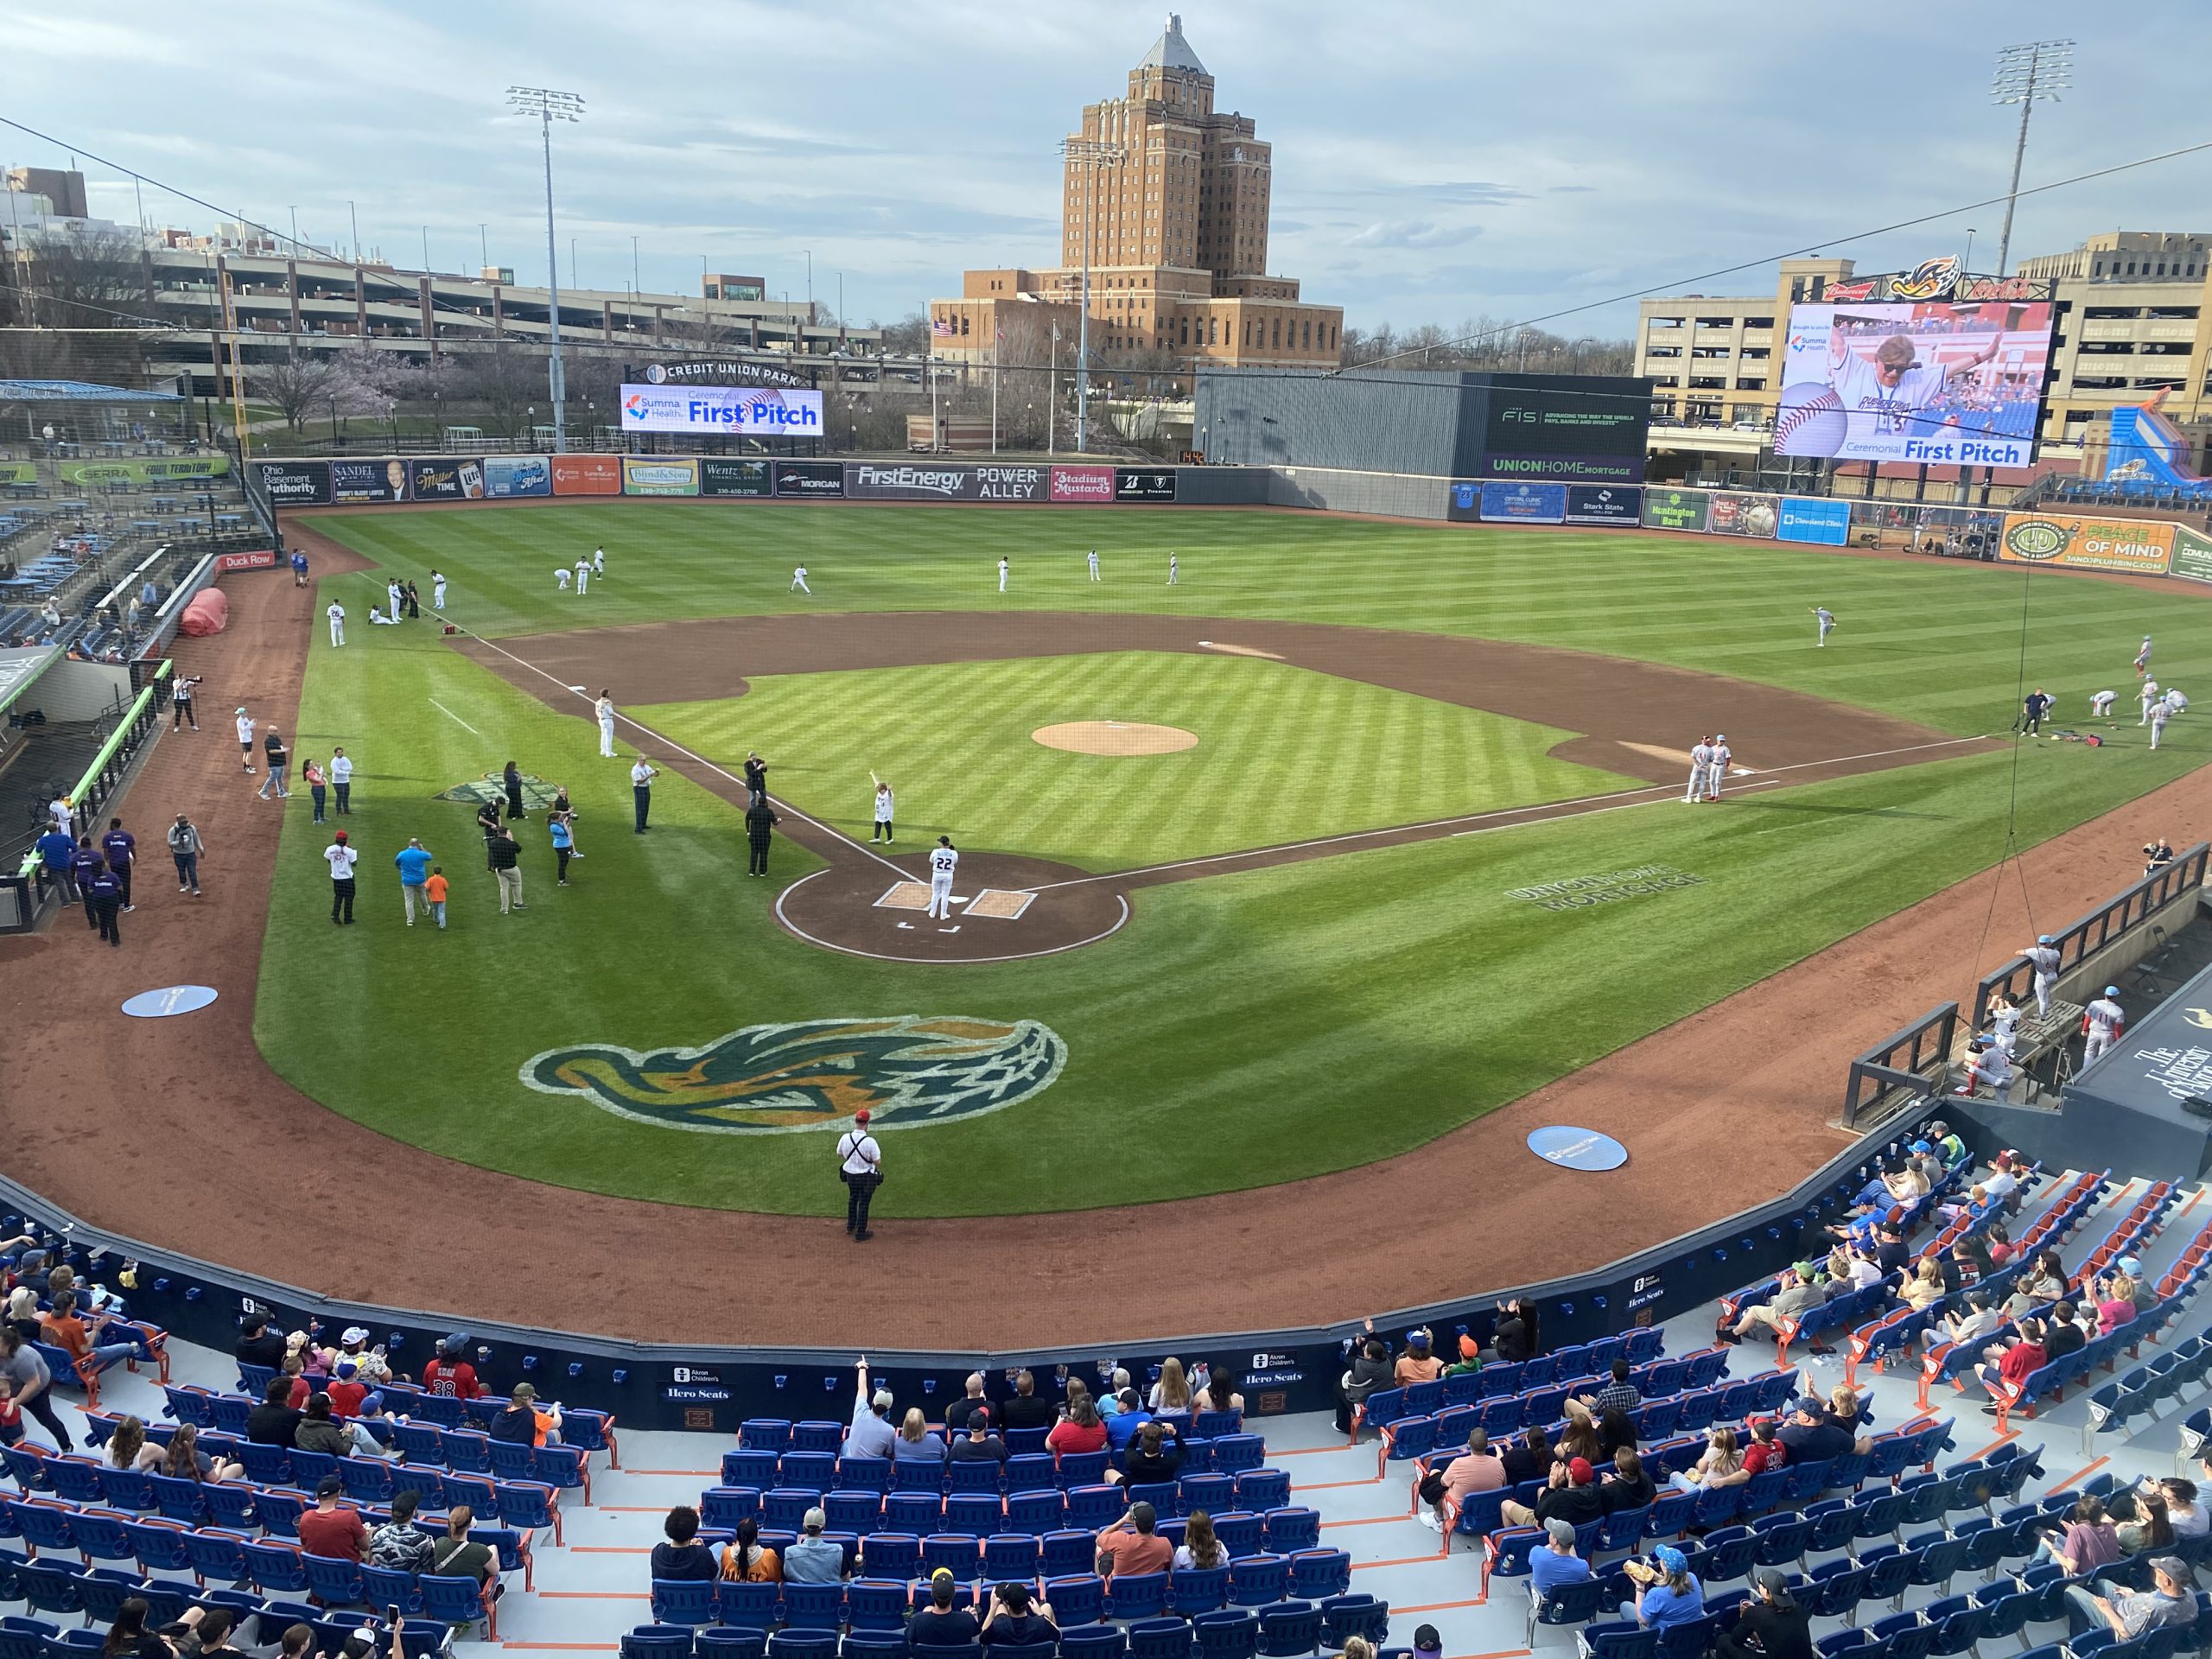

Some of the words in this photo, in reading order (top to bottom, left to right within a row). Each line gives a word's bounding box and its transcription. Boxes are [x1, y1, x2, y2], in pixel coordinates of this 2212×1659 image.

[1828, 286, 1869, 296] Budweiser
[667, 363, 714, 377] CREDIT
[718, 364, 760, 377] UNION
[763, 369, 798, 386] PARK
[688, 391, 740, 400] Ceremonial
[642, 398, 680, 408] Summa
[652, 410, 680, 418] Health
[689, 401, 744, 423] First
[753, 404, 817, 425] Pitch
[1502, 410, 1536, 423] FIS
[1847, 442, 1901, 454] Ceremonial
[1905, 440, 1954, 460] First
[1961, 442, 2018, 463] Pitch
[263, 465, 283, 475] Ohio
[334, 465, 374, 476] SANDEL
[707, 464, 738, 475] Wentz
[977, 467, 1037, 483] POWER
[264, 474, 311, 484] Basement
[416, 471, 454, 491] Miller
[521, 475, 547, 489] After
[858, 467, 964, 490] FirstEnergy
[1055, 472, 1109, 486] Stadium
[265, 483, 315, 495] Authority
[436, 482, 456, 491] TIME
[979, 484, 1034, 499] ALLEY
[1054, 481, 1110, 494] Mustard
[1652, 505, 1695, 518] Huntington
[1662, 517, 1683, 526] Bank
[1795, 517, 1825, 526] Cleveland
[1826, 518, 1844, 527] Clinic
[2012, 522, 2042, 534] PLUMBING
[2044, 523, 2065, 539] HEATING
[2087, 524, 2149, 543] PEACE
[2085, 540, 2110, 554] OF
[2114, 542, 2164, 558] MIND
[226, 553, 247, 567] Duck
[251, 553, 270, 566] Row
[2066, 555, 2162, 570] JANDJPLUMBING.COM
[937, 856, 952, 870] 22
[1535, 873, 1711, 912] MORTGAGE
[2098, 1012, 2108, 1024] 11
[2133, 1047, 2179, 1065] The
[1629, 1298, 1645, 1308] Hero
[1646, 1289, 1664, 1300] Seats
[267, 1327, 283, 1337] eats
[1246, 1376, 1272, 1384] Hero
[1274, 1372, 1302, 1382] Seats
[433, 1379, 456, 1396] 38
[668, 1388, 696, 1398] Hero
[698, 1389, 729, 1399] Seats
